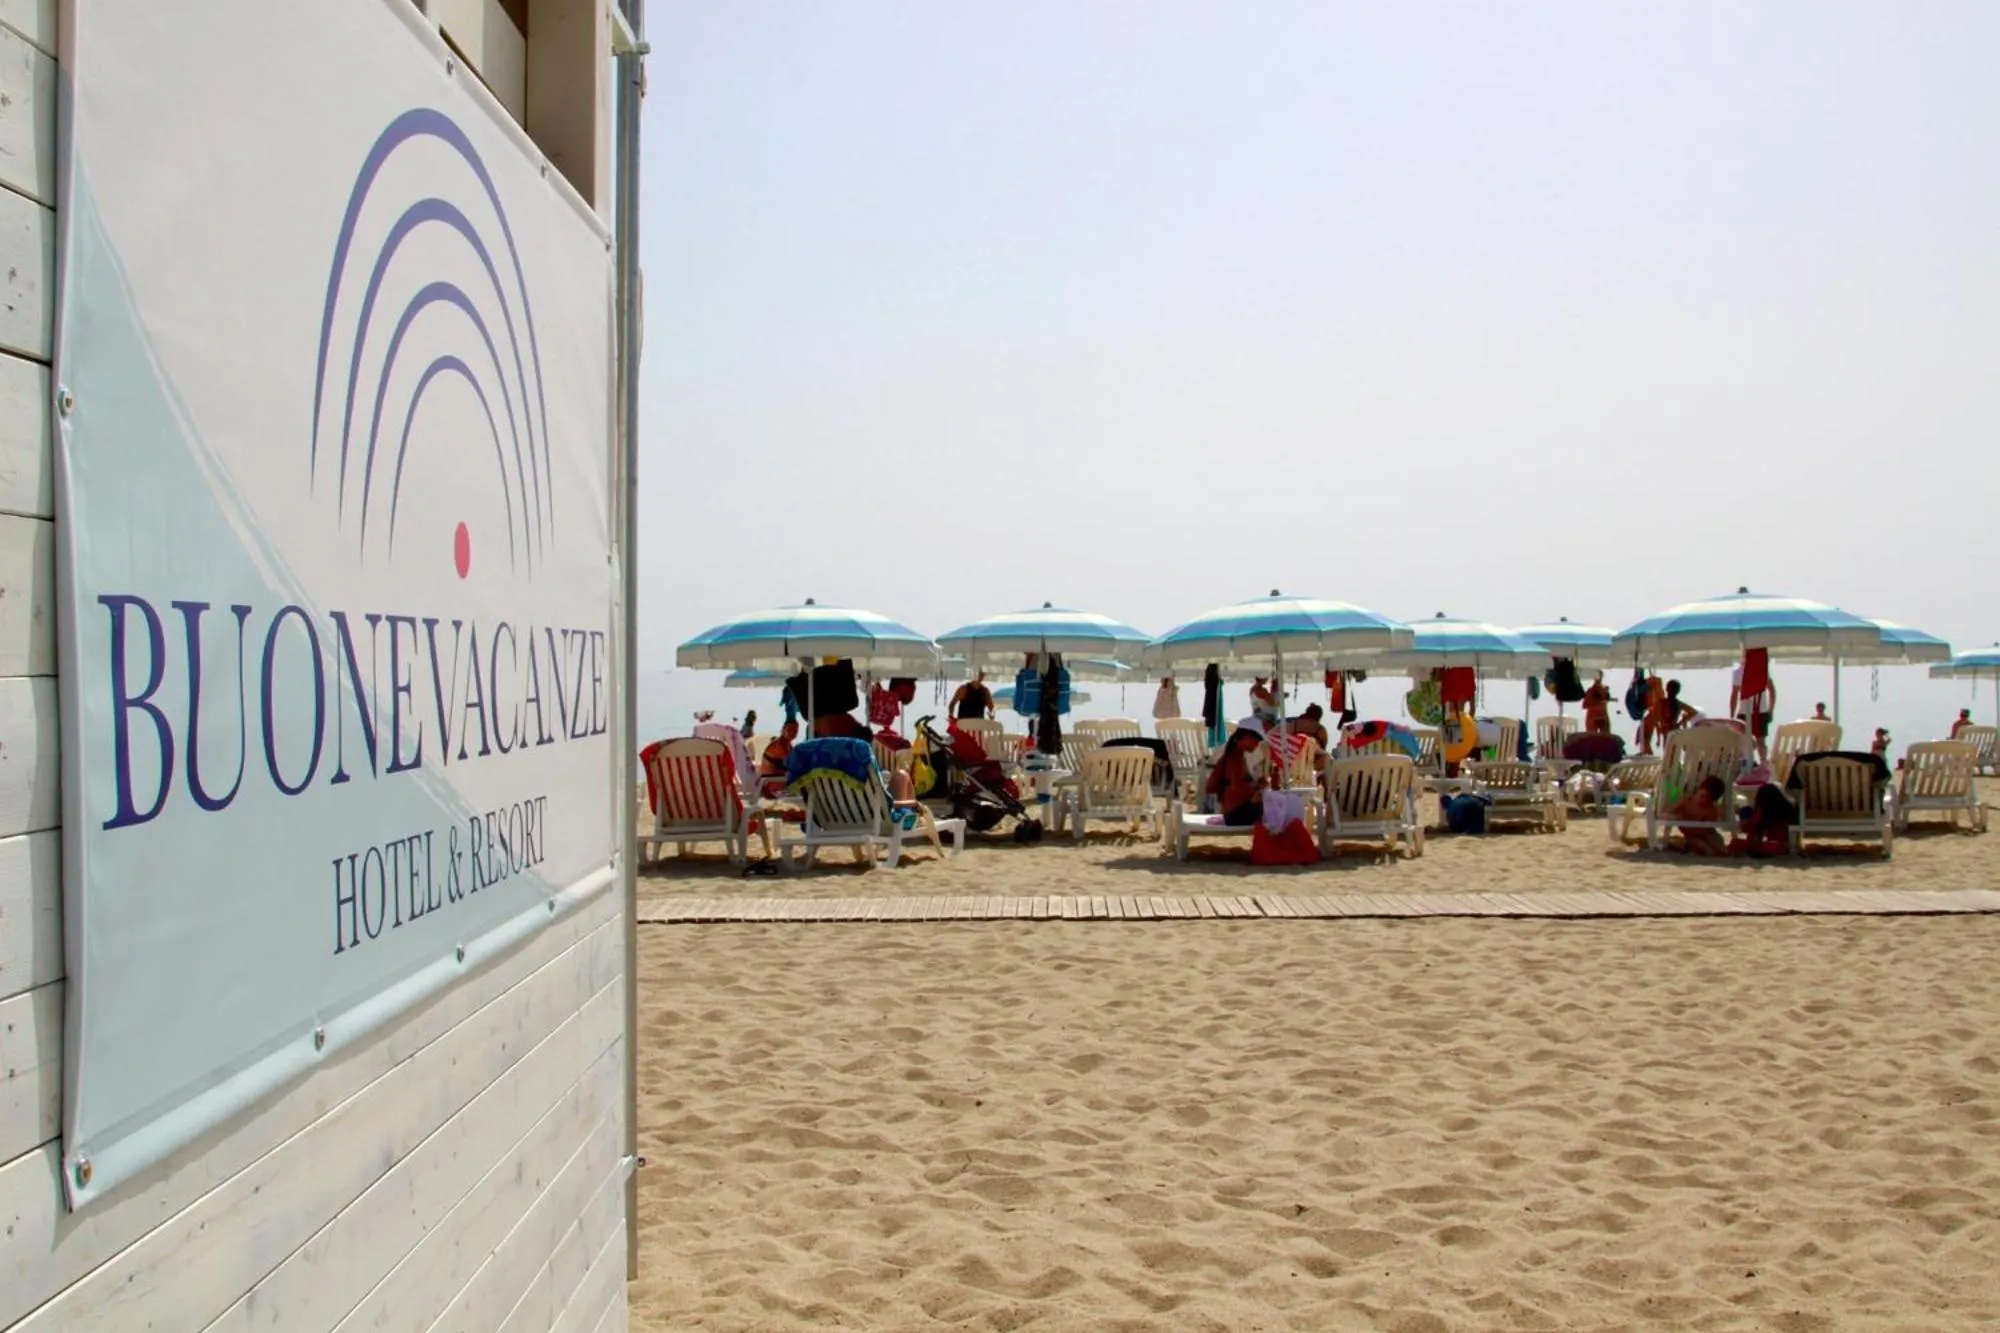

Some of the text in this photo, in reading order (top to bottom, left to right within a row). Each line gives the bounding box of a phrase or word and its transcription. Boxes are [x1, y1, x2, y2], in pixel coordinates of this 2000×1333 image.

[97, 594, 608, 831] BUONEVACANZE
[332, 796, 547, 955] HOTEL & RESORT
